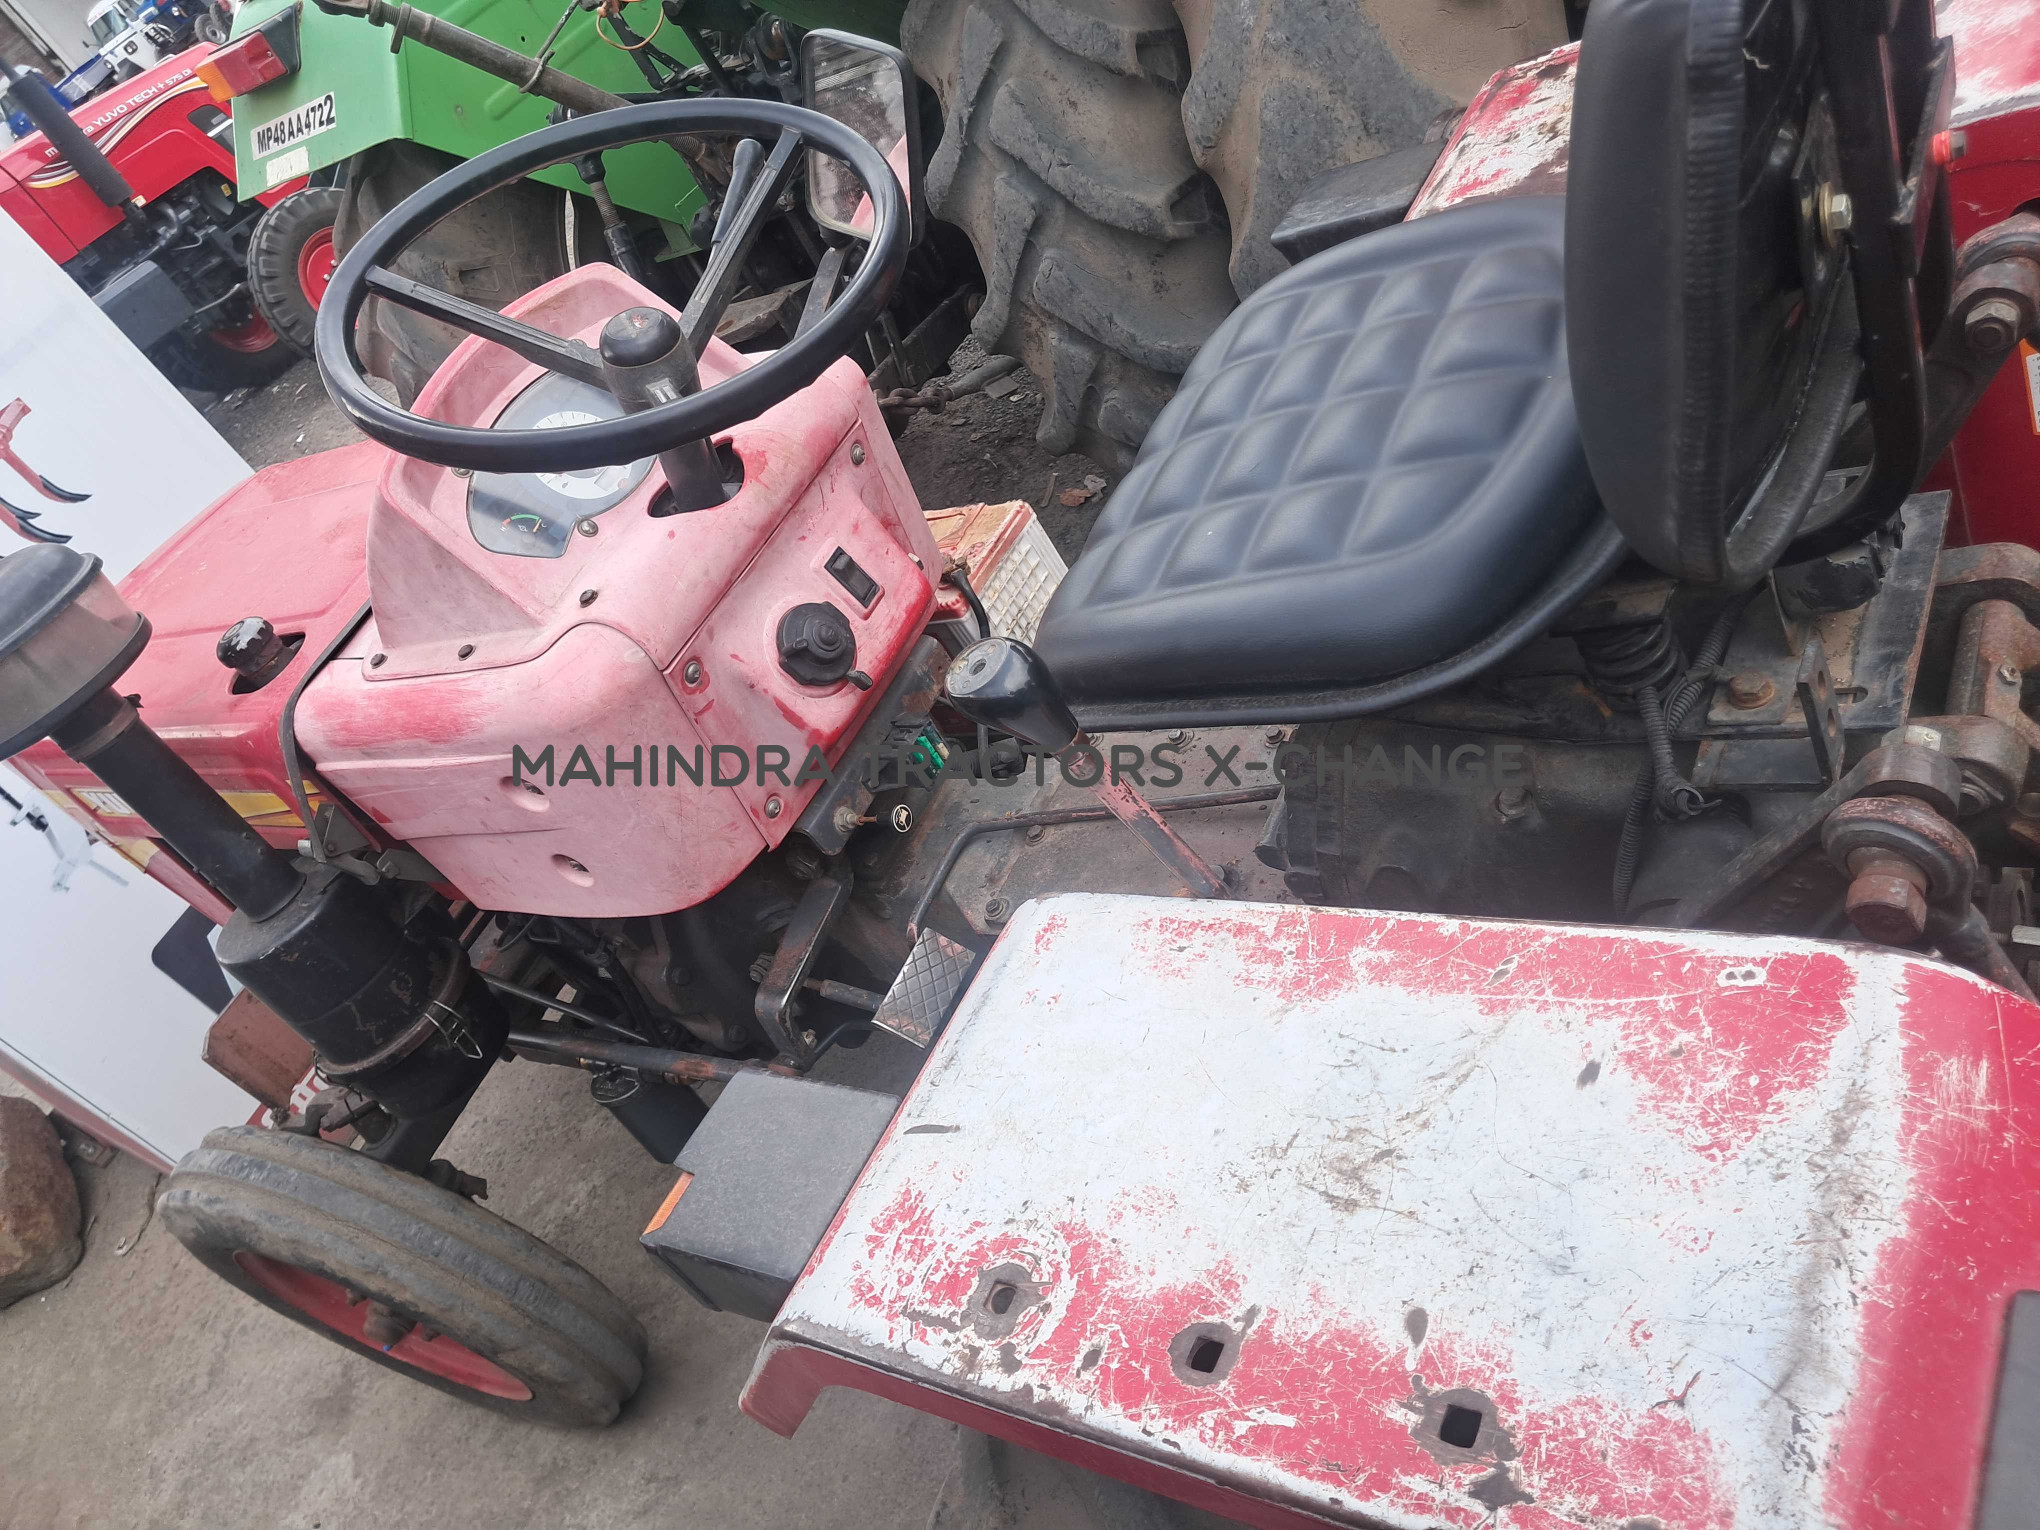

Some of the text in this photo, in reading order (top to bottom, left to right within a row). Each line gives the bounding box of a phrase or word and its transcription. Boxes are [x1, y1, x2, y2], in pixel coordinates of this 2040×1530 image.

[93, 104, 127, 126] YUVO
[126, 86, 158, 107] TECH
[165, 72, 183, 86] 575
